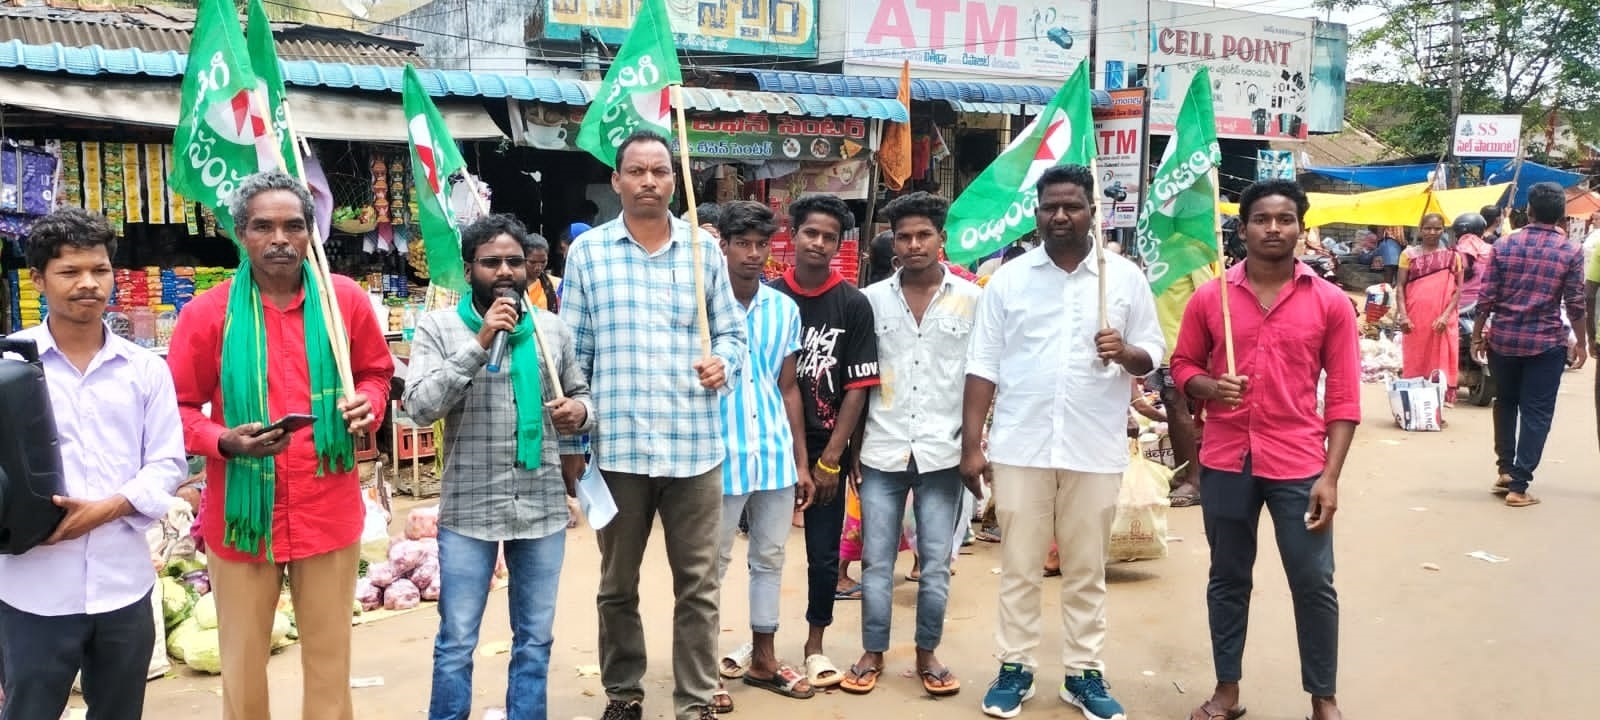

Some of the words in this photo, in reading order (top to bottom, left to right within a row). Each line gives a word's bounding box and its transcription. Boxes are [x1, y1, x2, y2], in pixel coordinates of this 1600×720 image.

[865, 0, 1018, 57] ATM
[1158, 27, 1216, 59] CELL
[1222, 34, 1291, 66] POINT
[1095, 129, 1137, 155] TM
[1478, 122, 1497, 136] SS
[847, 366, 853, 378] I
[855, 361, 880, 377] LOV
